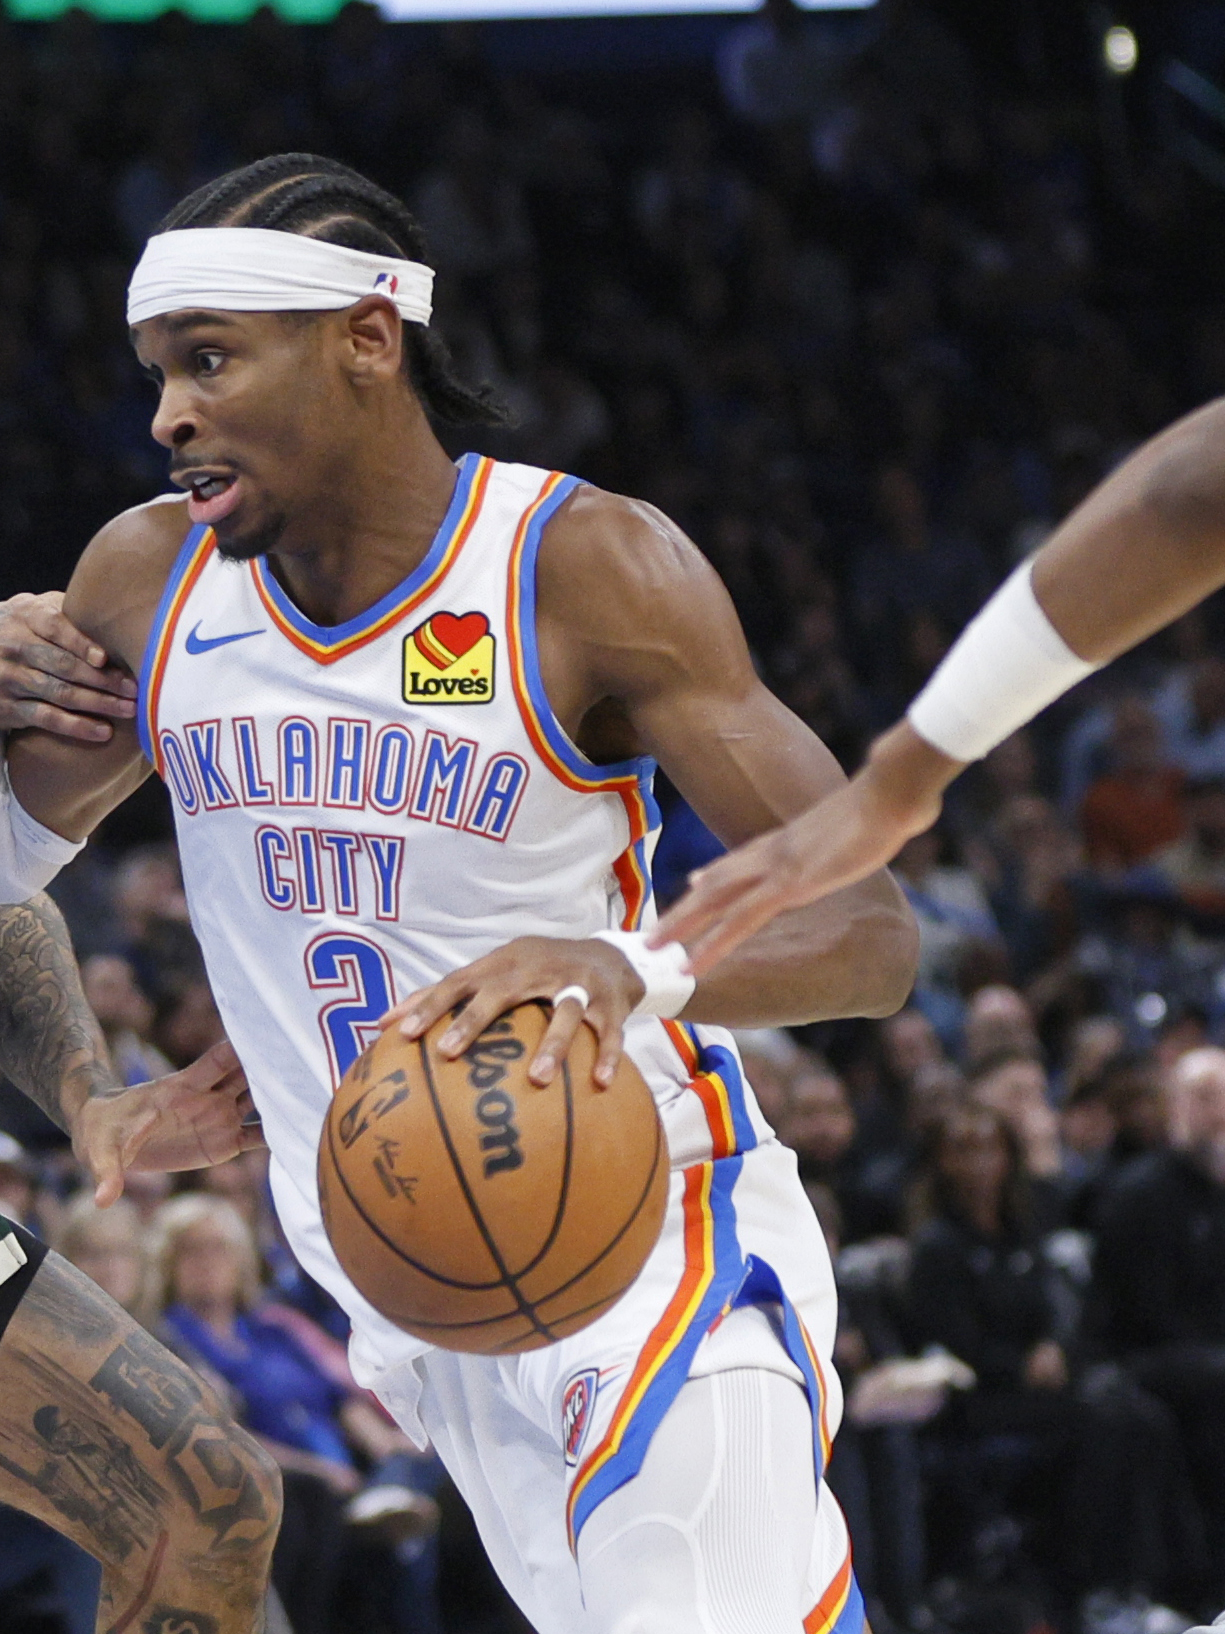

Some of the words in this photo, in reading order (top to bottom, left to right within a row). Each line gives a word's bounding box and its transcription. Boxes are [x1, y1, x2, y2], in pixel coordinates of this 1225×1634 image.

[159, 715, 530, 842] OKLAHOMA
[254, 824, 406, 921] CITY
[304, 931, 397, 1097] 2
